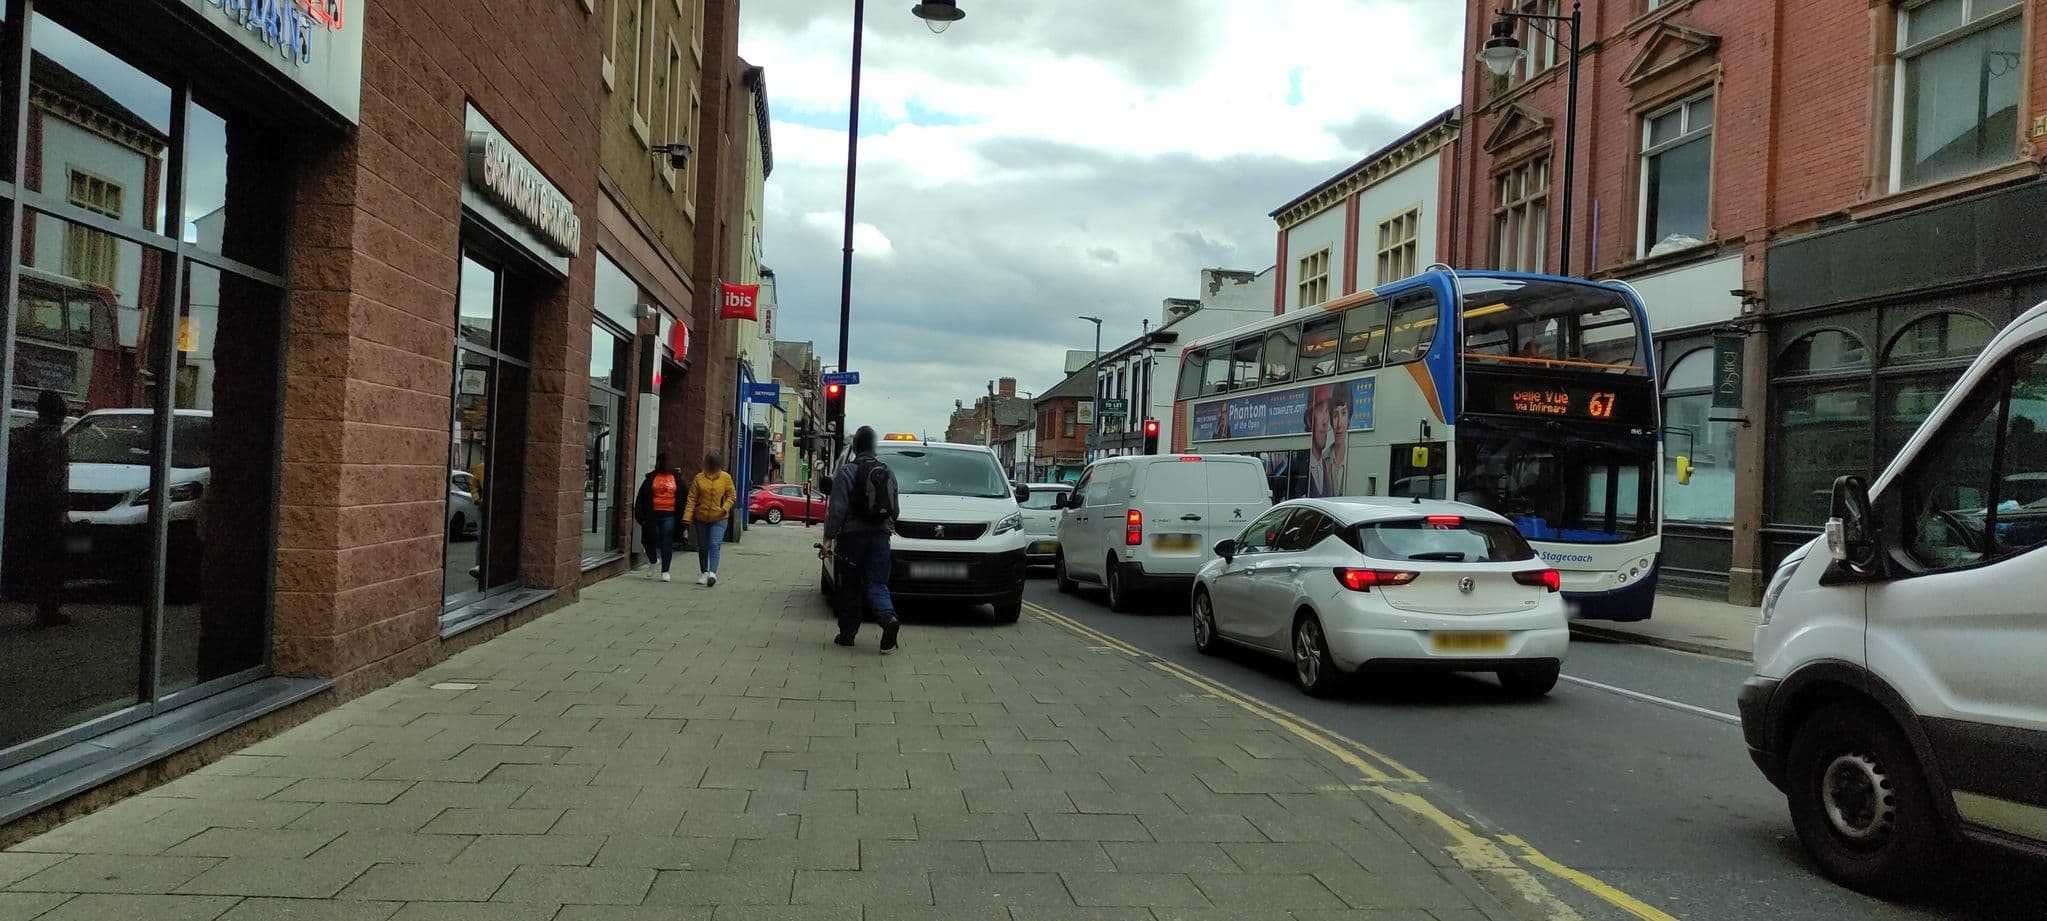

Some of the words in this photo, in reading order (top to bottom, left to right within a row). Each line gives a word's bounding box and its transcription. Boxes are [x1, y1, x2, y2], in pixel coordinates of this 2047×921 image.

[725, 291, 752, 307] ibis
[1545, 391, 1568, 404] Vue
[1589, 391, 1616, 417] 67
[1229, 403, 1267, 420] Phantom
[1515, 402, 1528, 411] via
[1530, 402, 1567, 414] Infirmary
[1234, 422, 1239, 430] of
[1239, 421, 1247, 429] the
[1248, 419, 1260, 430] Open
[1542, 551, 1593, 563] Stagecoach
